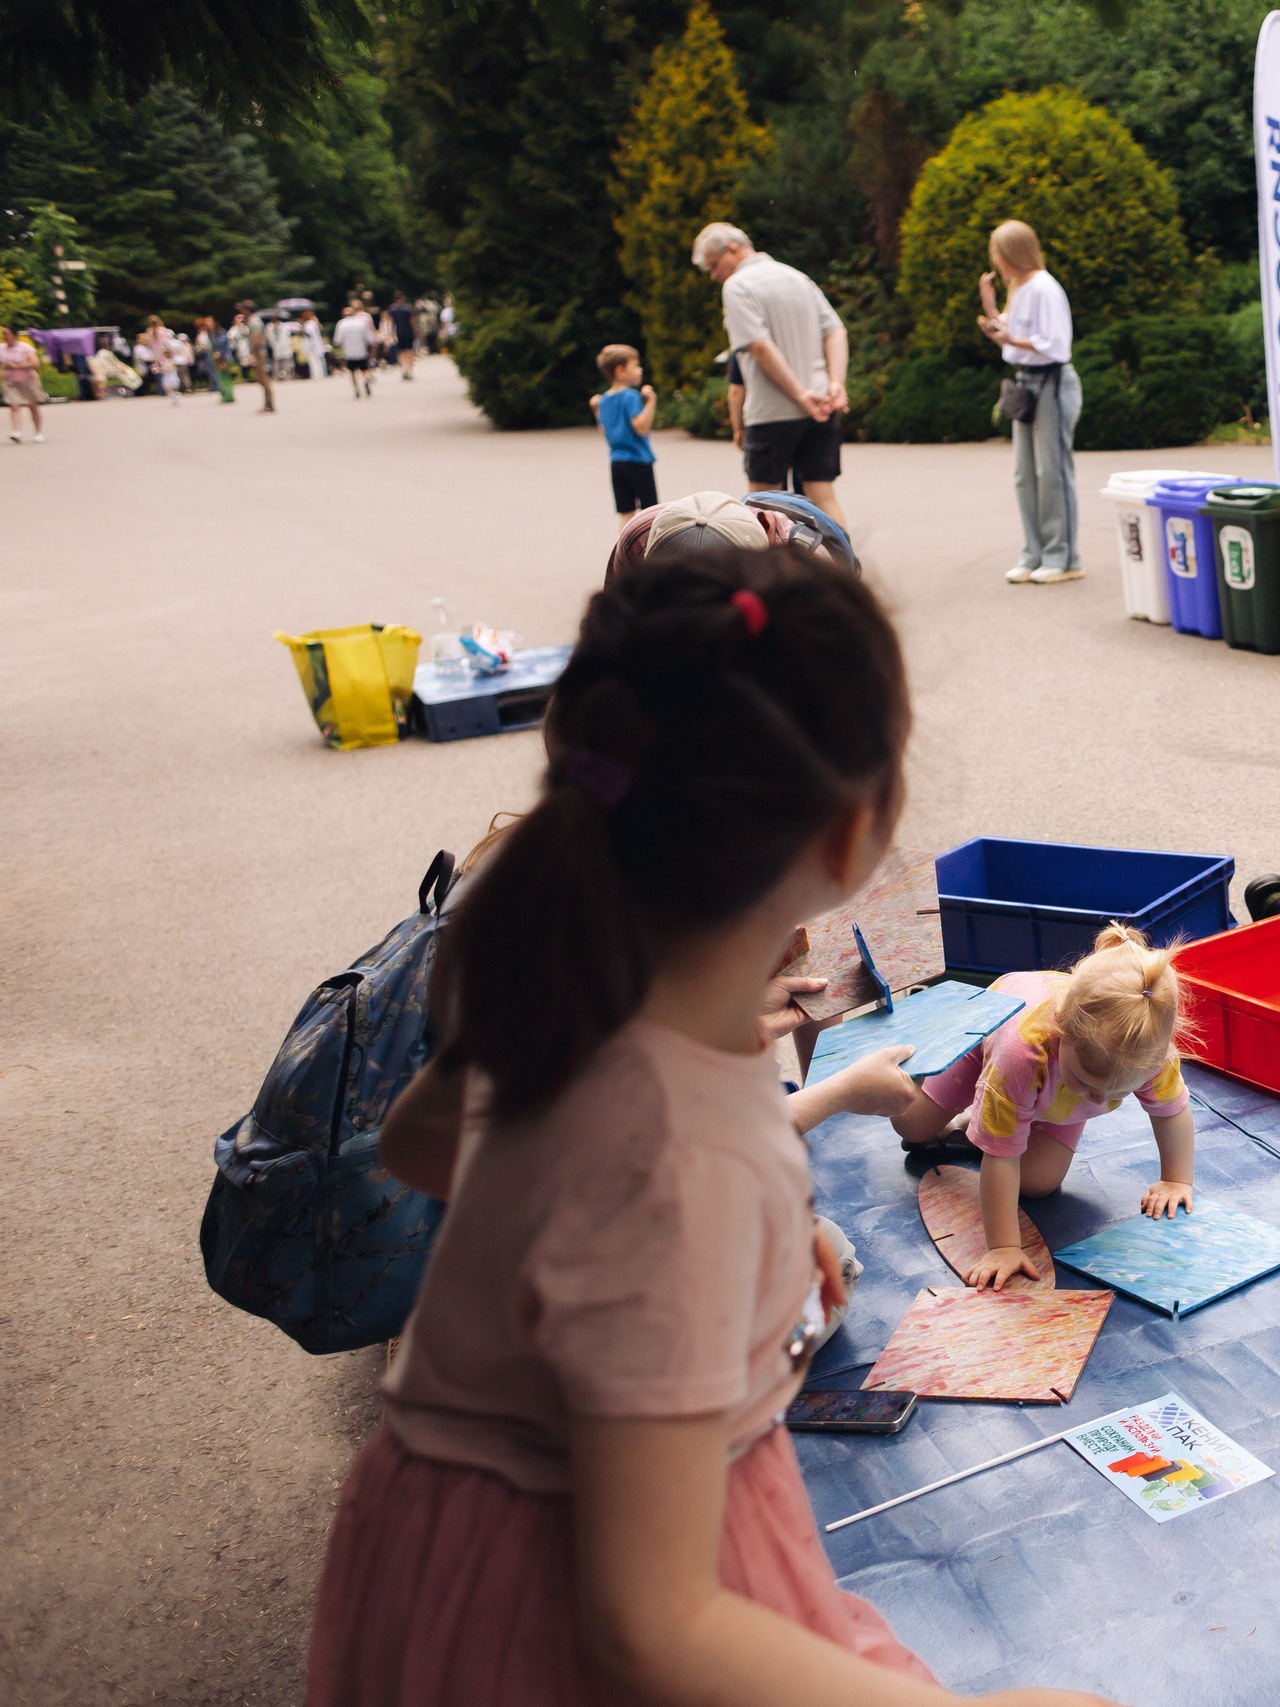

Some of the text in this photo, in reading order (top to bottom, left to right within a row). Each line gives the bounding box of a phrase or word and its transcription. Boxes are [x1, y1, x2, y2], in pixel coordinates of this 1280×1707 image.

[1075, 1434, 1106, 1455] ВМЕСТЕ
[1087, 1429, 1121, 1453] ПРИРОДУ
[1100, 1425, 1137, 1454] СОХРАНИМ
[1124, 1424, 1164, 1454] ИСПОЛЬЗУЙ
[1166, 1425, 1203, 1451] ПАК
[1182, 1418, 1235, 1453] КЕНИГ
